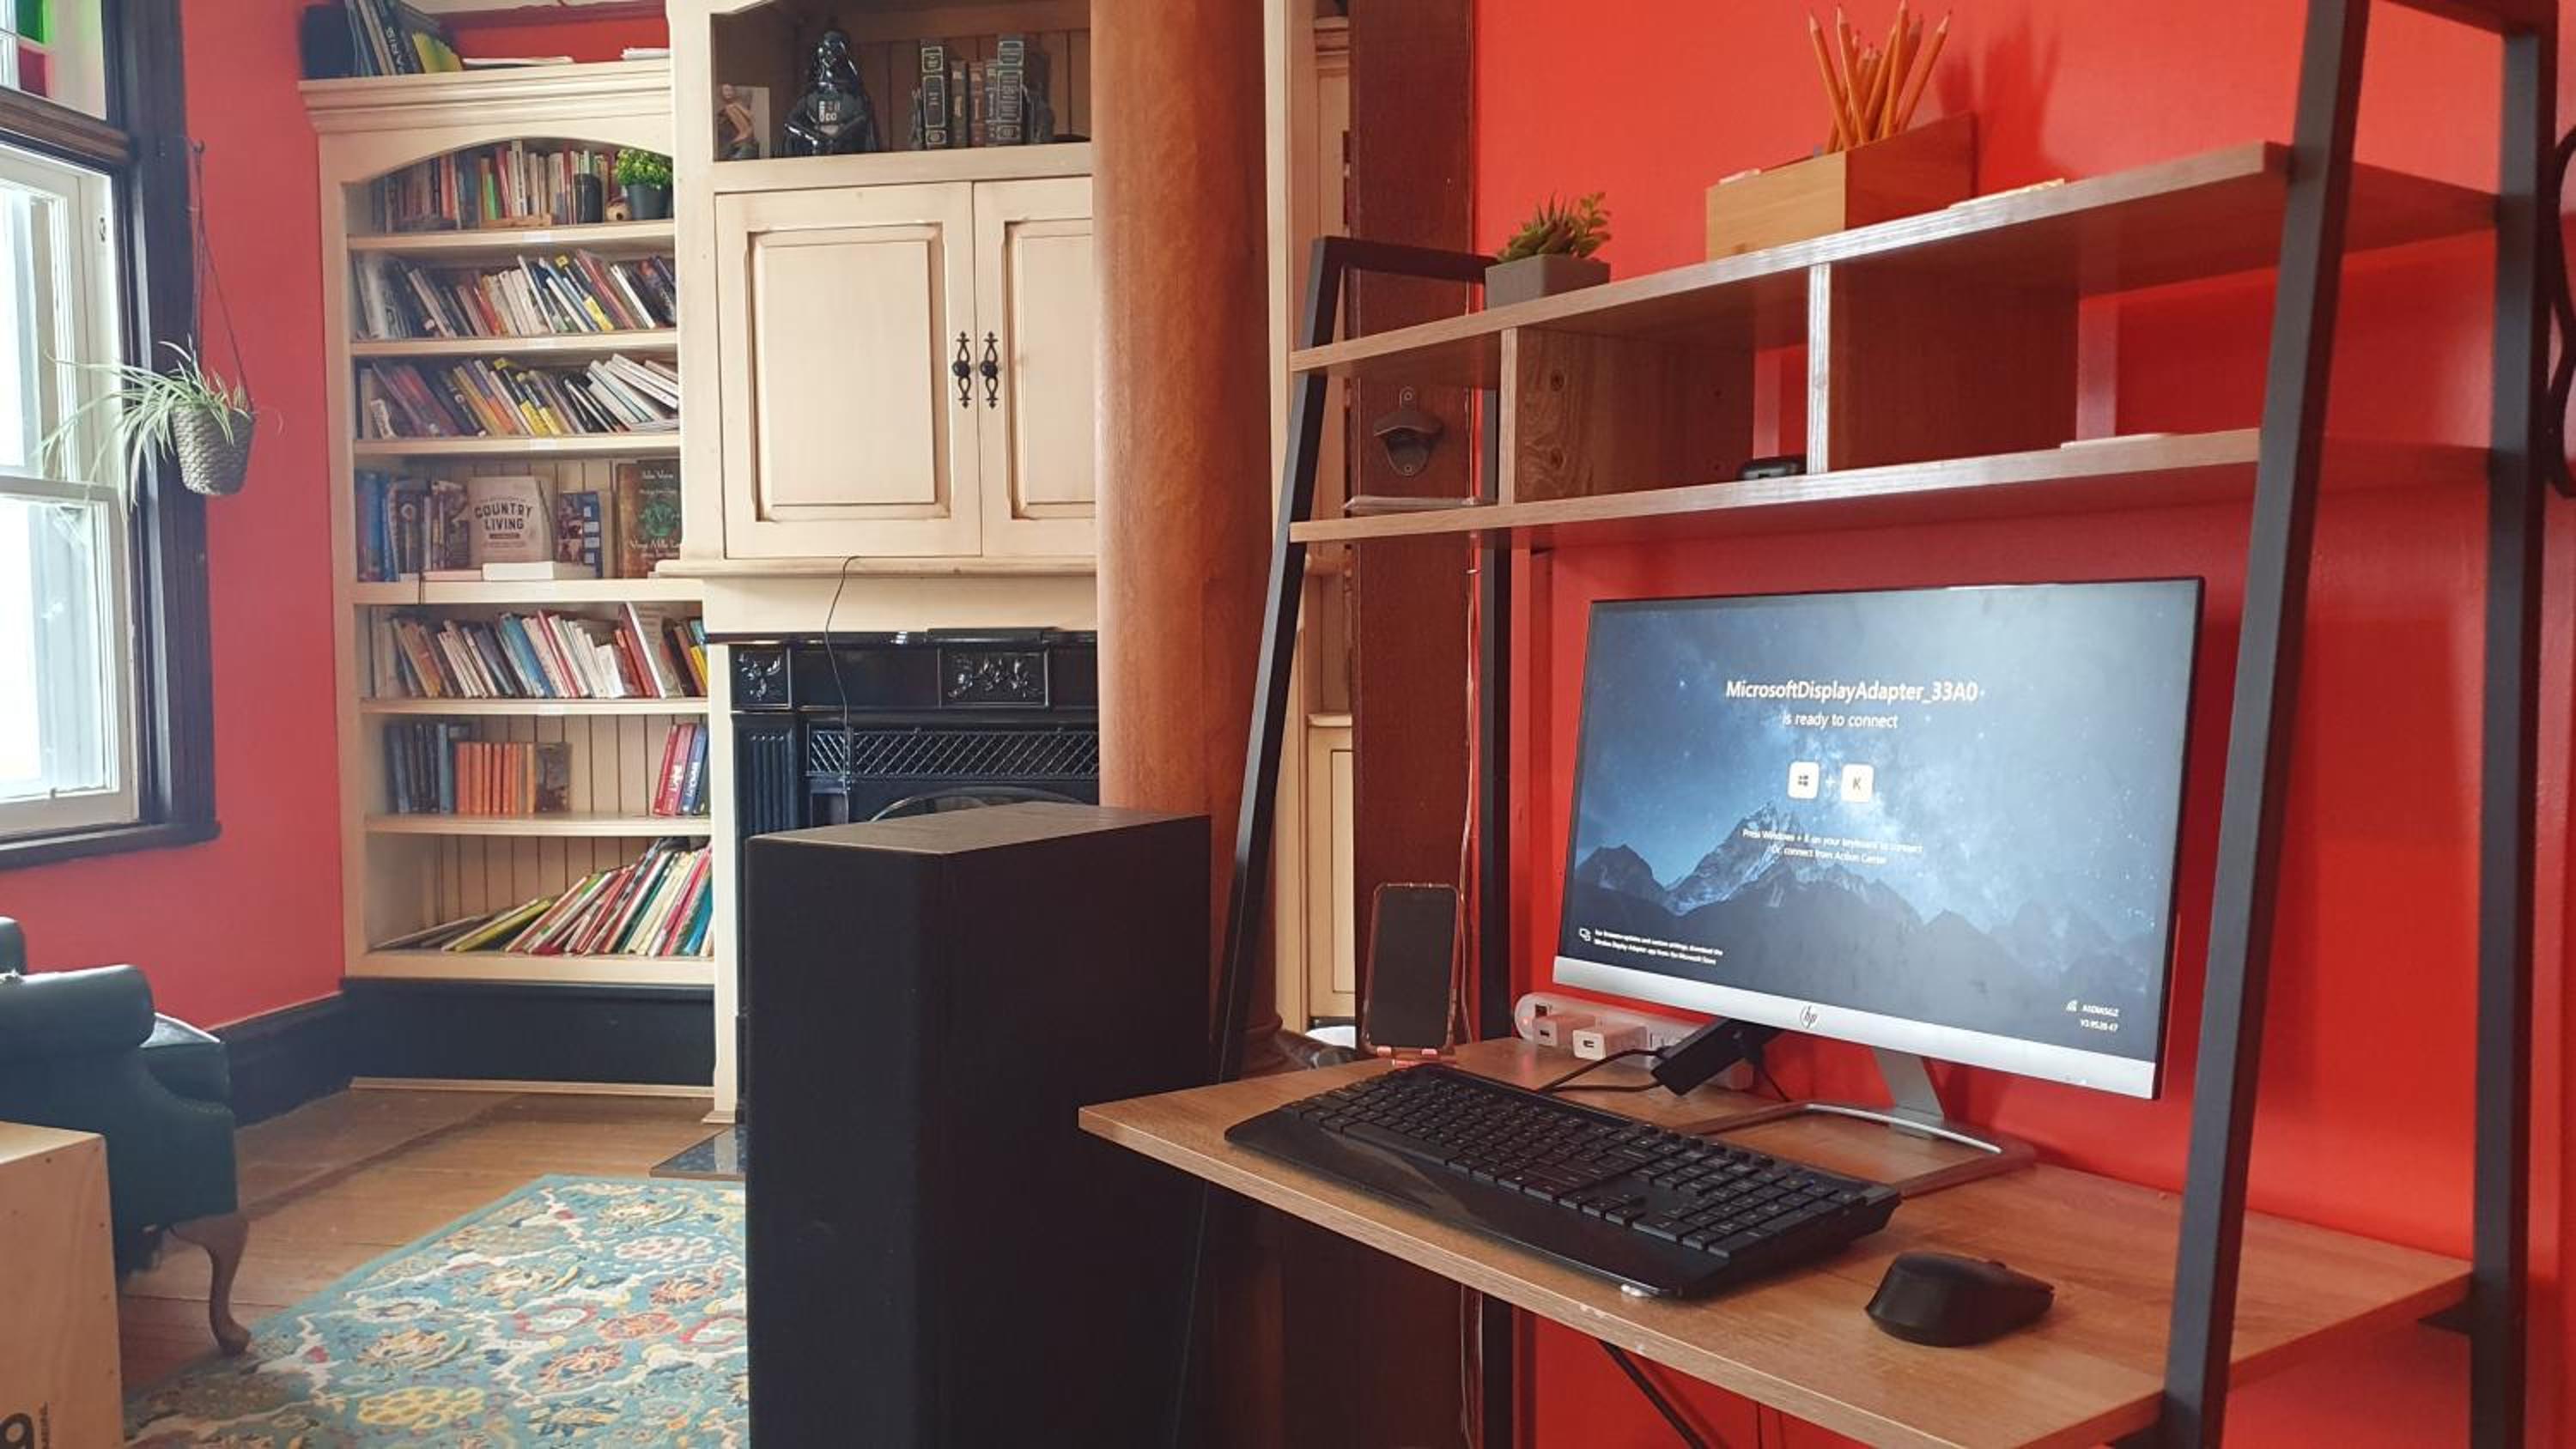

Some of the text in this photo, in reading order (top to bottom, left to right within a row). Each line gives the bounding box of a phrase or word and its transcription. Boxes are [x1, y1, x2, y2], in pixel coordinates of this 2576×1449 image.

[474, 502, 533, 519] COUNTRY
[484, 518, 524, 530] LIVING
[1725, 680, 1979, 705] MicrosoftDisplayAdapter_33A0
[1782, 712, 1899, 730] is ready to connect
[1762, 830, 1795, 842] Windows
[1823, 836, 1841, 846] your
[1842, 836, 1878, 850] keyboard
[1891, 842, 1923, 853] connect
[1783, 847, 1814, 858] connect
[1815, 849, 1833, 860] from
[1834, 852, 1861, 863] Action
